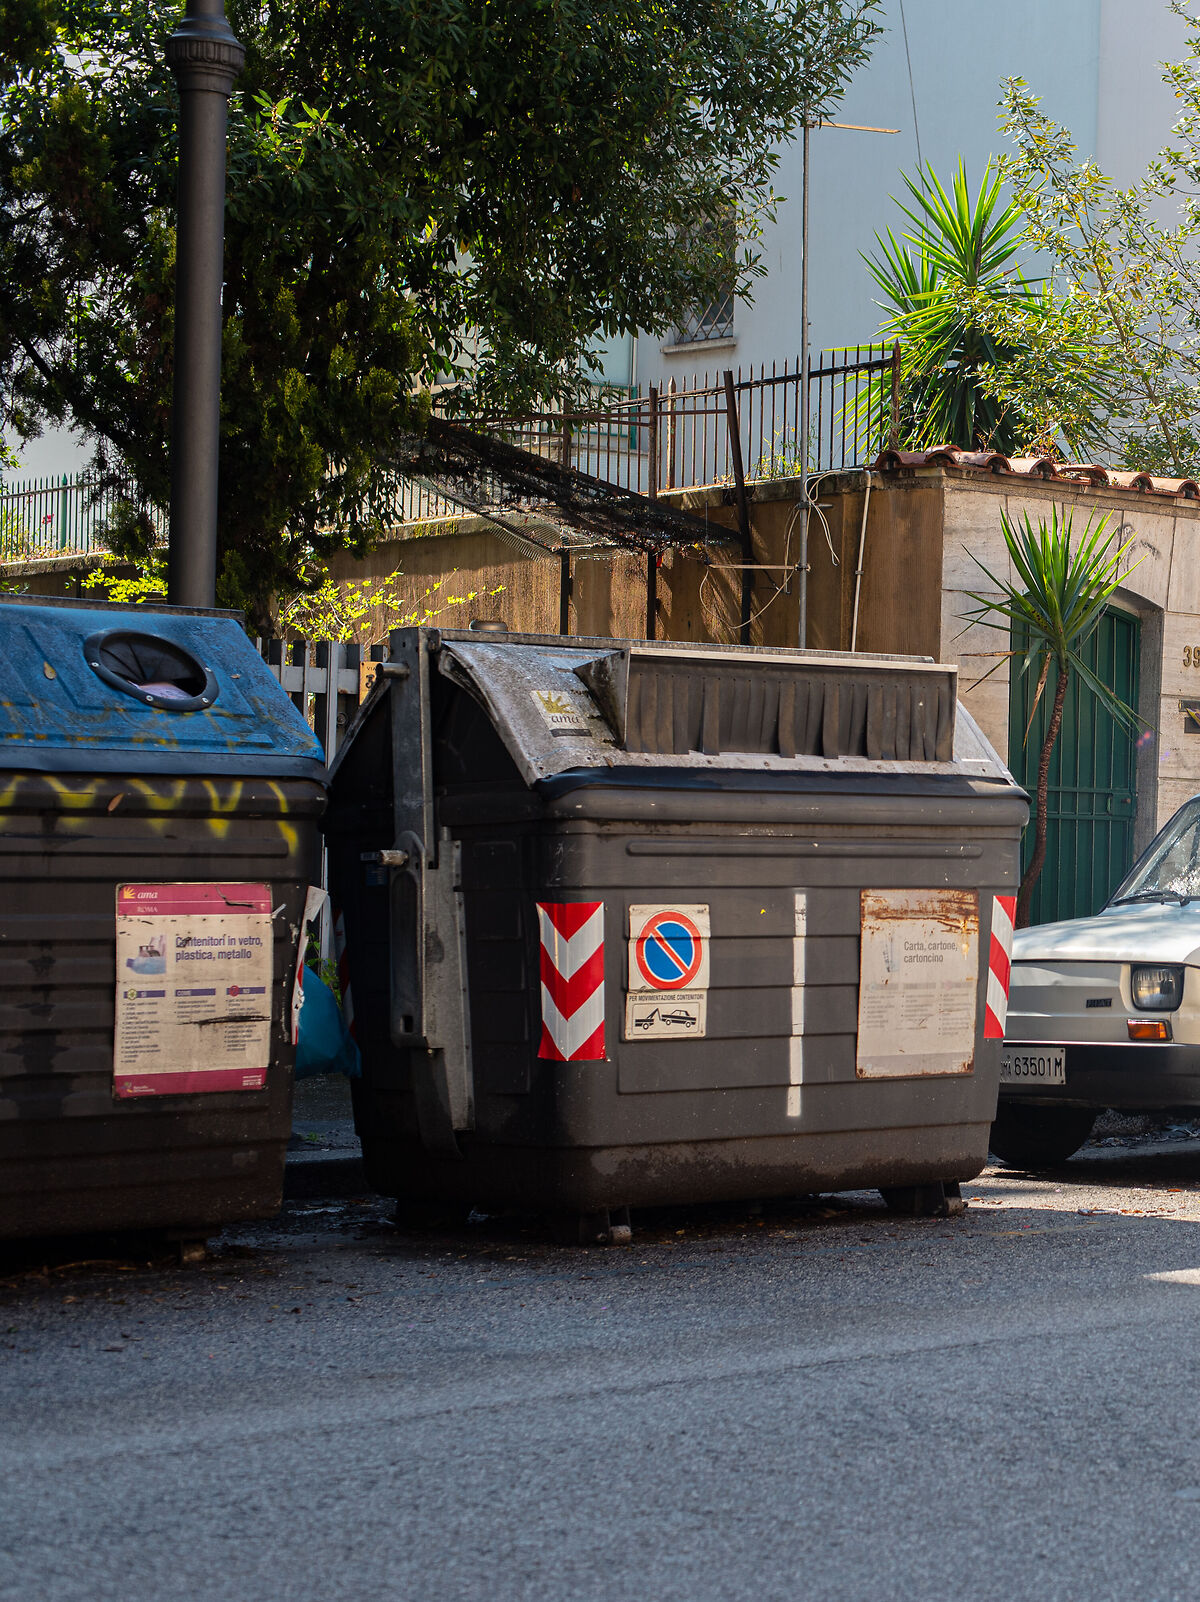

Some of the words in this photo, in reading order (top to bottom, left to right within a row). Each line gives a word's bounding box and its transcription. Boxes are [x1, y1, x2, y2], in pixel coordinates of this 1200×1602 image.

[551, 715, 580, 723] ama
[137, 891, 158, 899] ama
[228, 935, 236, 946] in
[238, 935, 263, 947] vetro,
[904, 941, 927, 951] Carta,
[928, 941, 958, 952] cartone,
[175, 949, 216, 963] plastica,
[217, 948, 252, 960] metallo
[904, 953, 944, 963] cartoncino
[638, 994, 676, 1002] MOVIMENTAZIONE
[677, 993, 704, 1001] CONTENITORI
[1014, 1056, 1063, 1077] 63501M
